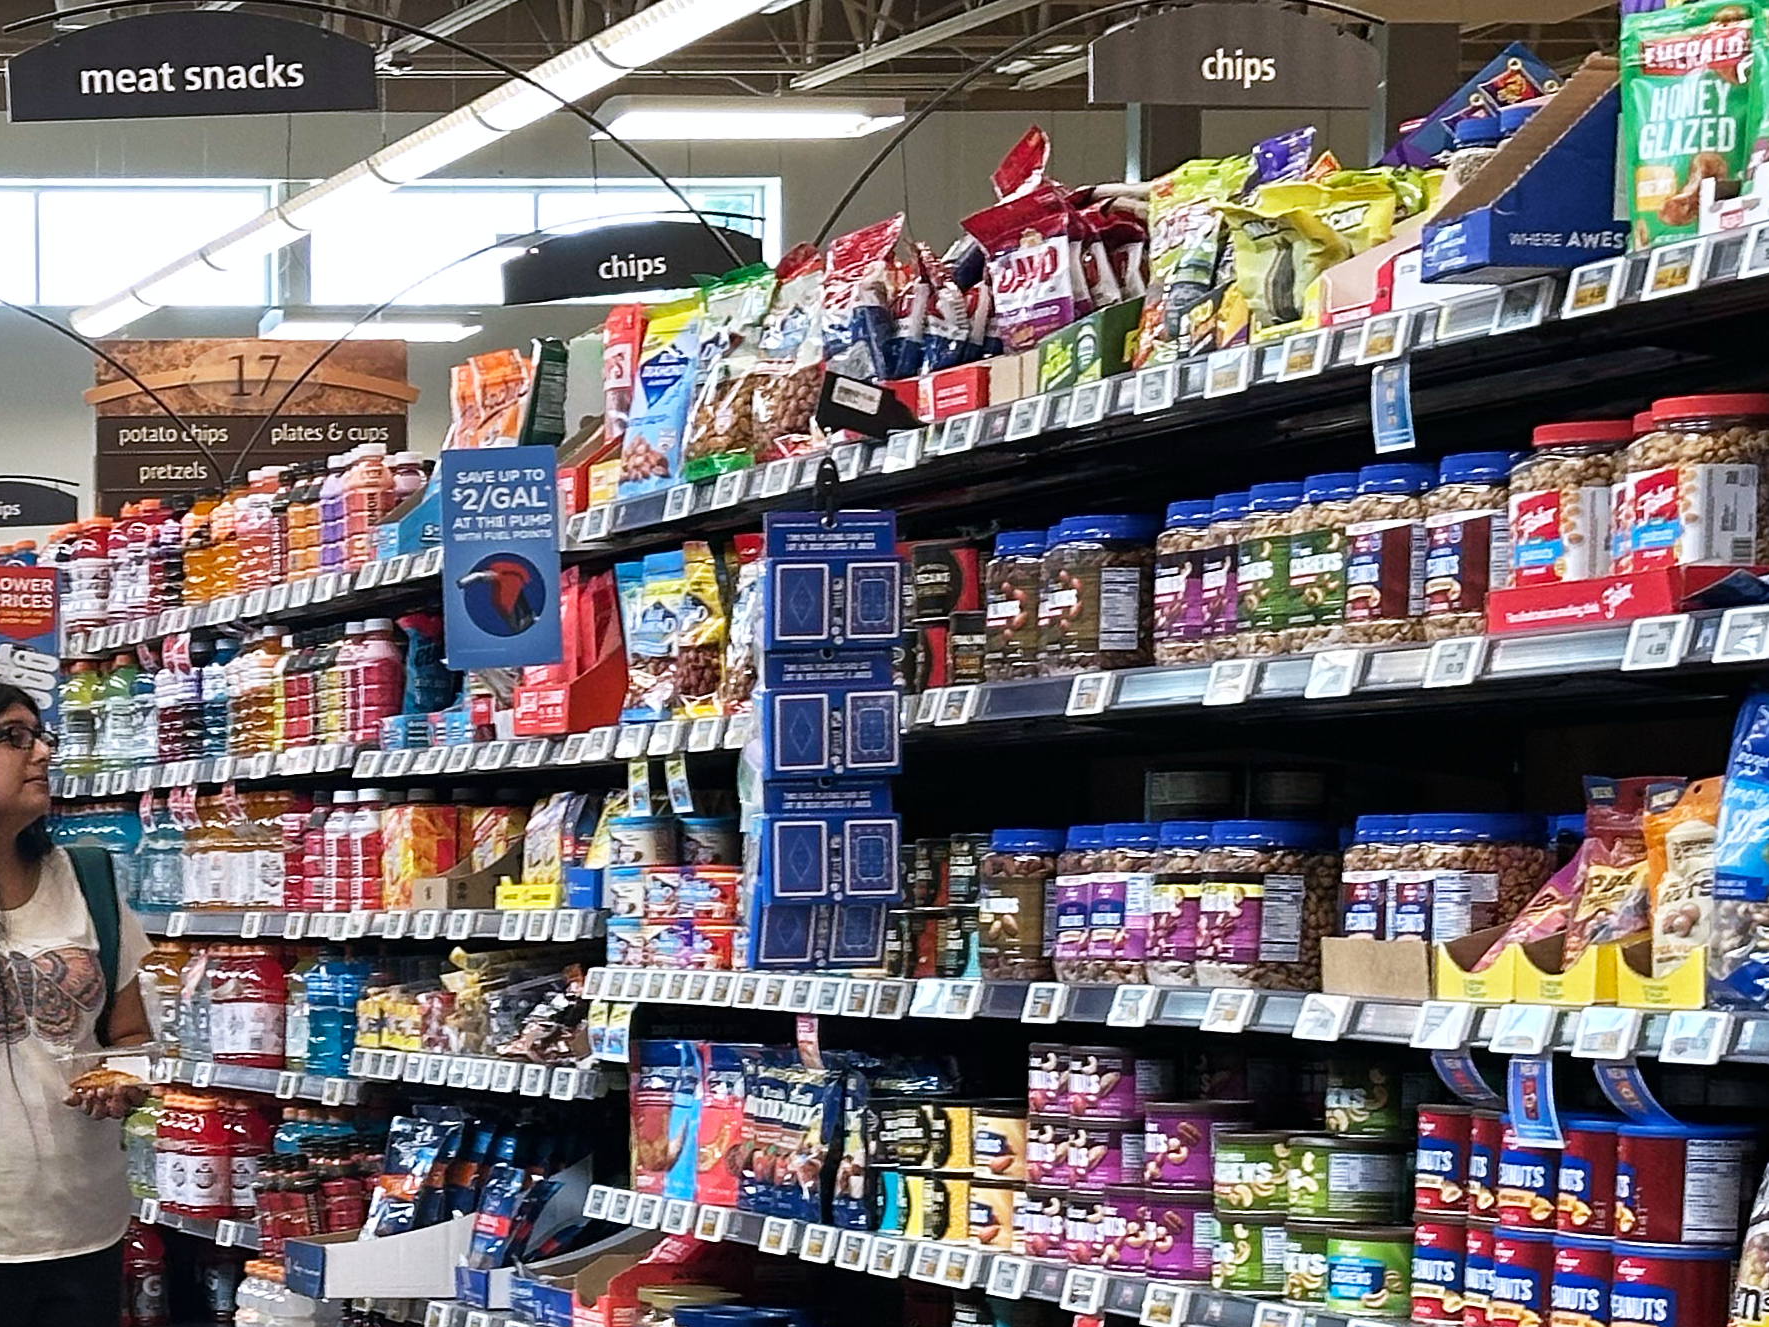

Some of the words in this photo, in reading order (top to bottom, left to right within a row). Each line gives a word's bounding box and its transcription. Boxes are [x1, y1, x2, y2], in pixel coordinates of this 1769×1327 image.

[80, 60, 175, 96] meat
[183, 55, 304, 91] snacks
[1202, 48, 1276, 88] chips
[1650, 80, 1730, 122] HONEY
[1638, 116, 1736, 160] GLAZED
[1509, 232, 1563, 247] WHERE
[598, 252, 667, 282] chips
[228, 354, 282, 397] 17
[119, 426, 178, 445] potato
[271, 423, 323, 445] plates
[347, 425, 389, 445] cups
[139, 461, 208, 484] pretzels
[456, 470, 496, 484] SAVE
[498, 469, 520, 482] UP
[523, 468, 546, 481] TO
